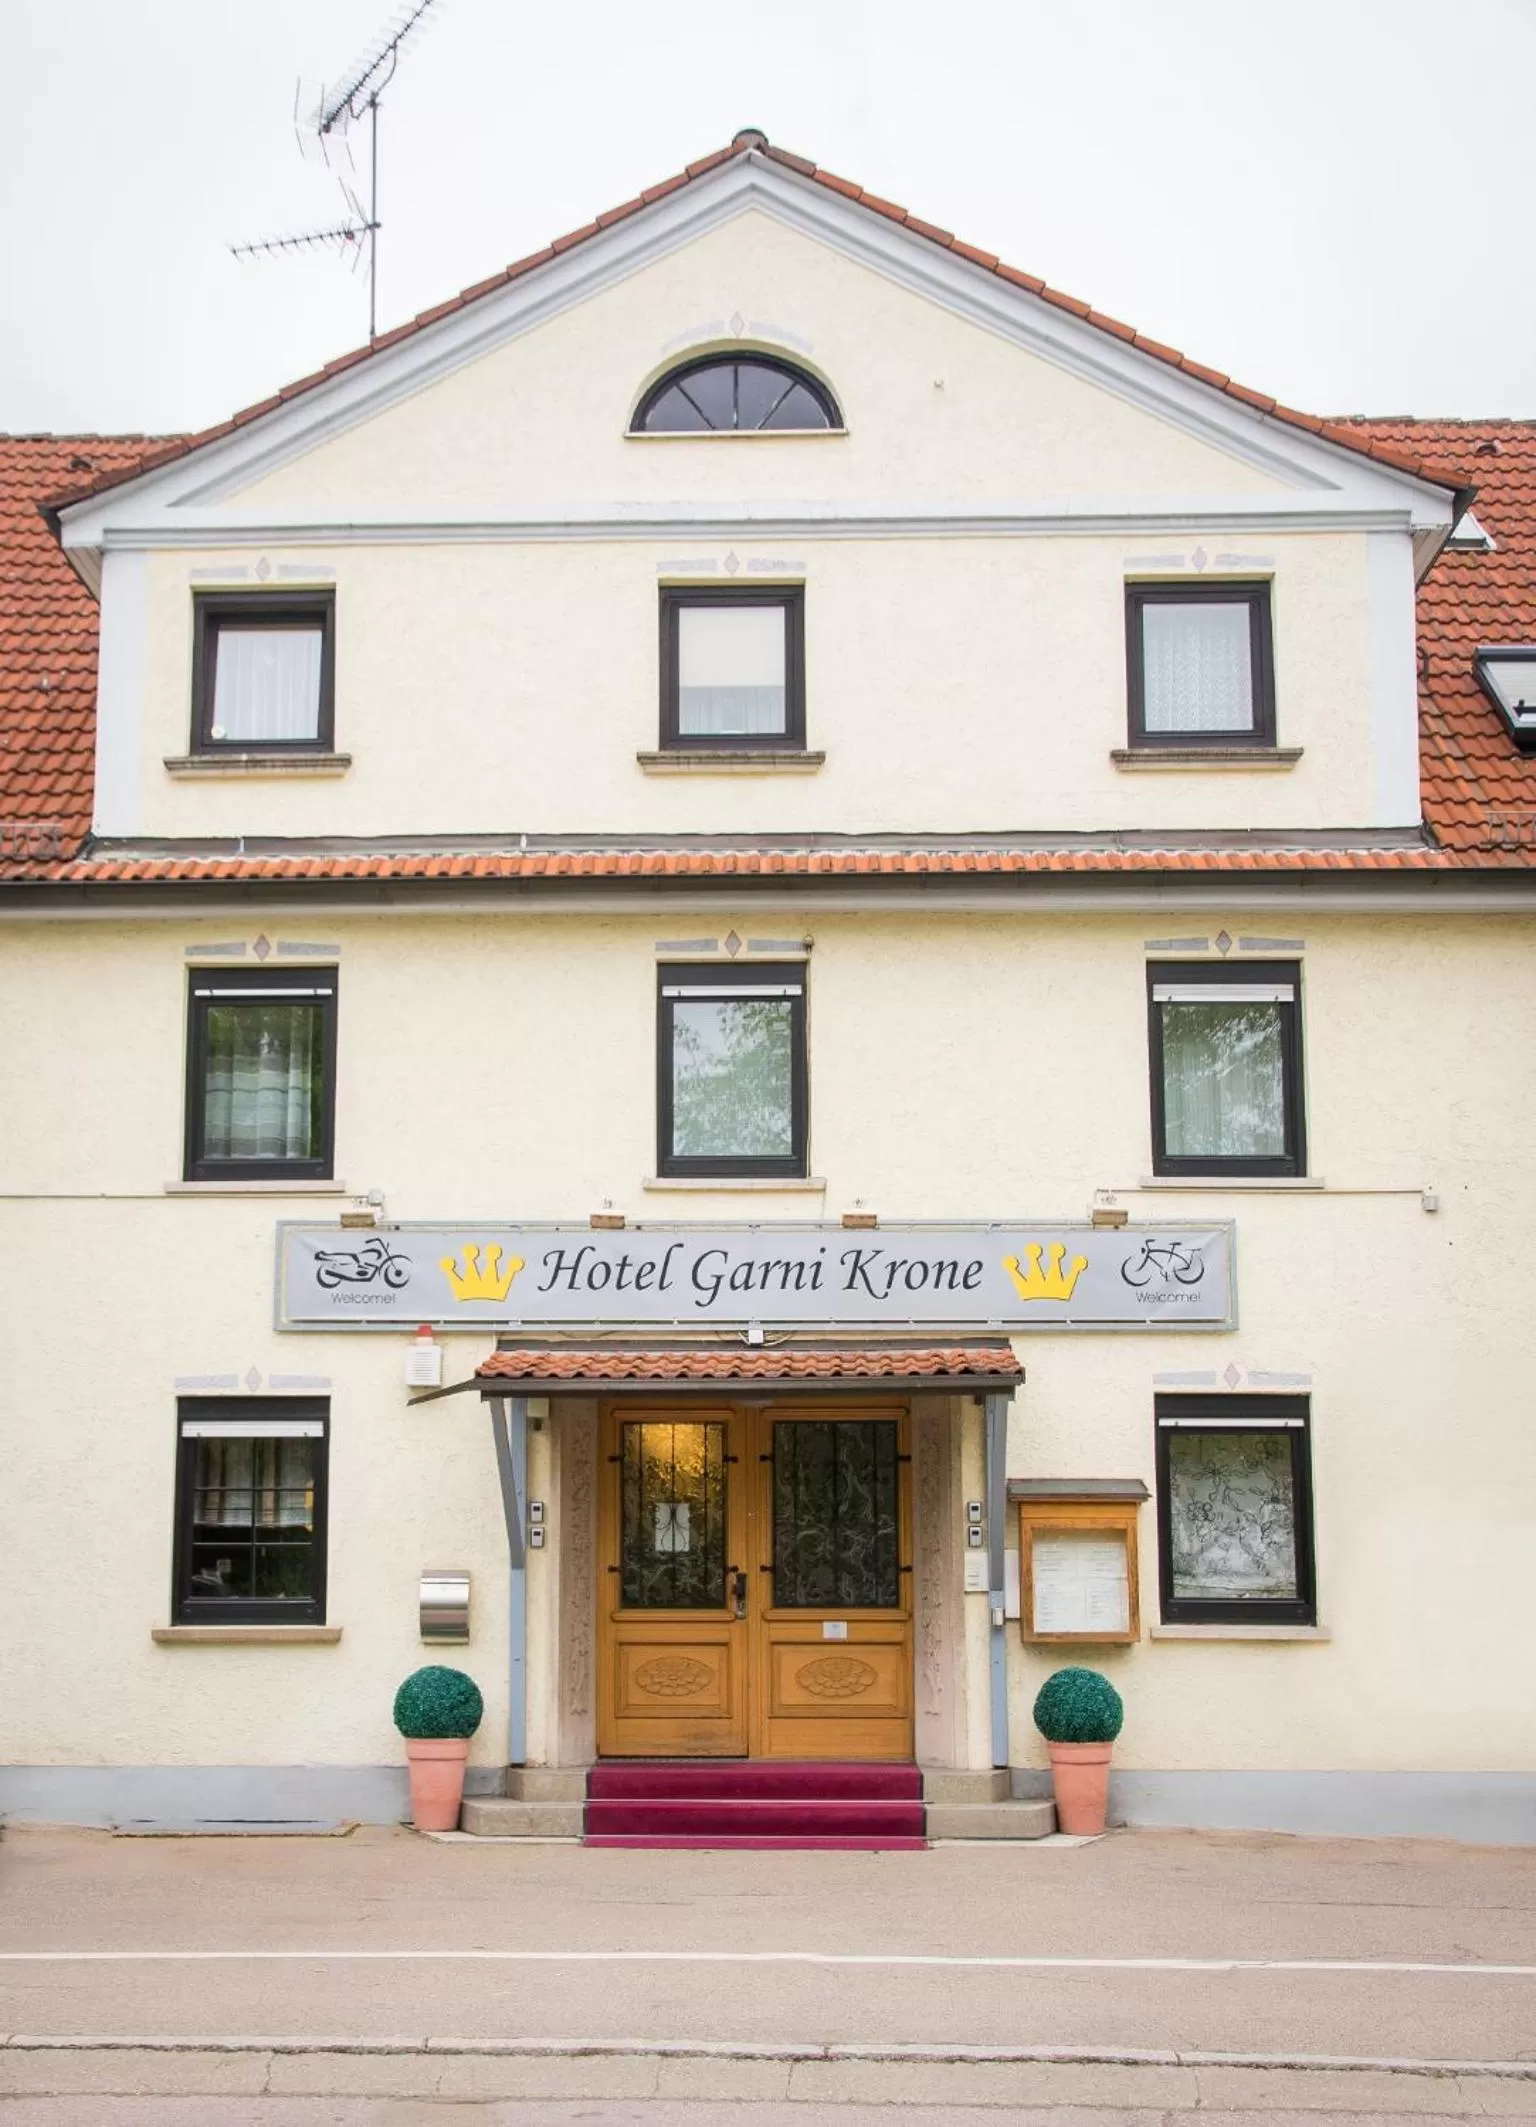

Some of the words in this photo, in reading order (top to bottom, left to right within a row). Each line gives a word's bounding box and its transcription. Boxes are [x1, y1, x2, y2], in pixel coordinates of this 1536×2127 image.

[537, 1243, 684, 1292] Hotel
[691, 1247, 826, 1307] Garni
[840, 1248, 983, 1299] Krone
[331, 1292, 396, 1305] Welcome!
[1136, 1291, 1202, 1304] Welcome!
